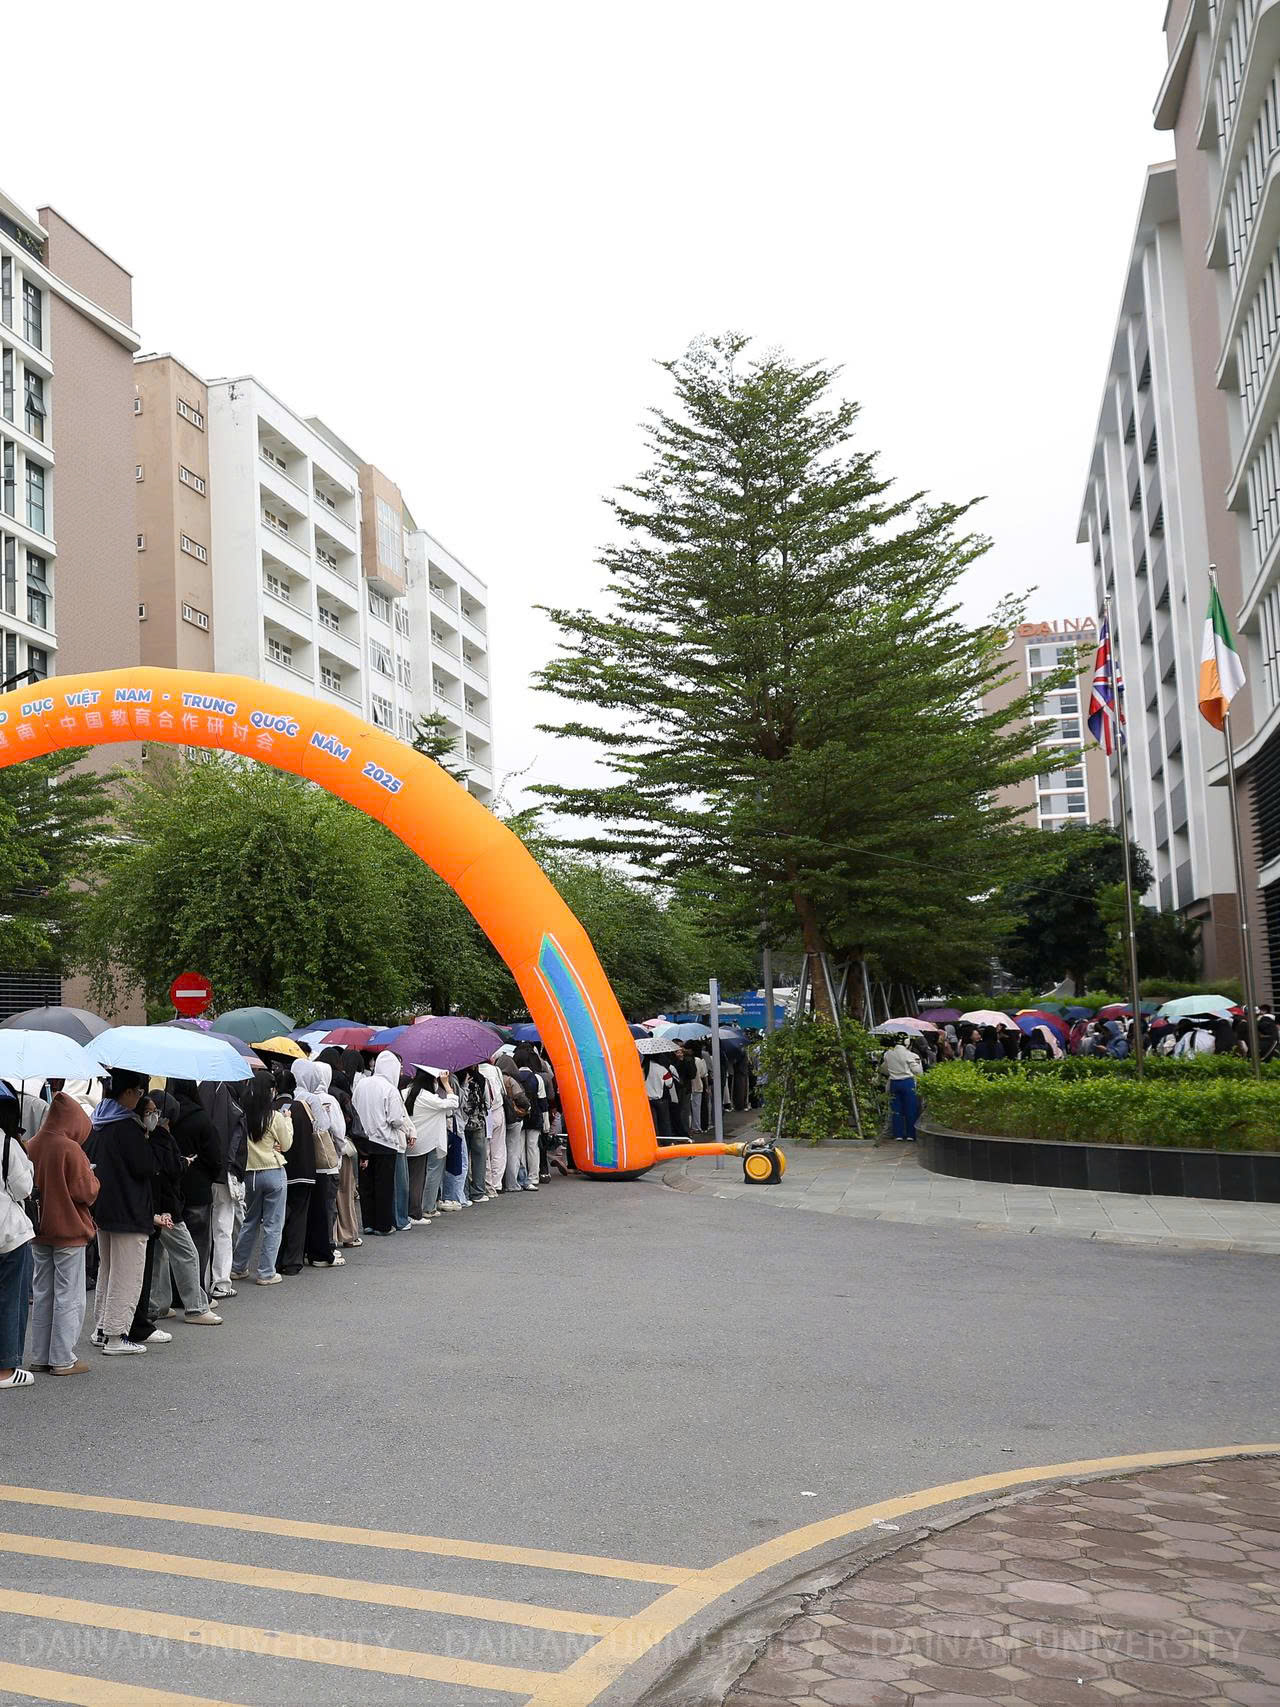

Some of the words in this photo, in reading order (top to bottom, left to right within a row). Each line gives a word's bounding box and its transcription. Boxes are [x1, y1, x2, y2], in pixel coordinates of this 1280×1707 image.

[1064, 616, 1097, 633] NA
[21, 698, 53, 717] DỤC
[65, 689, 101, 708] VIỆT
[115, 688, 152, 703] NAM
[182, 692, 237, 717] TRUNG
[249, 711, 299, 738] QUỐC
[310, 731, 351, 762] NĂM
[362, 762, 403, 794] 2025
